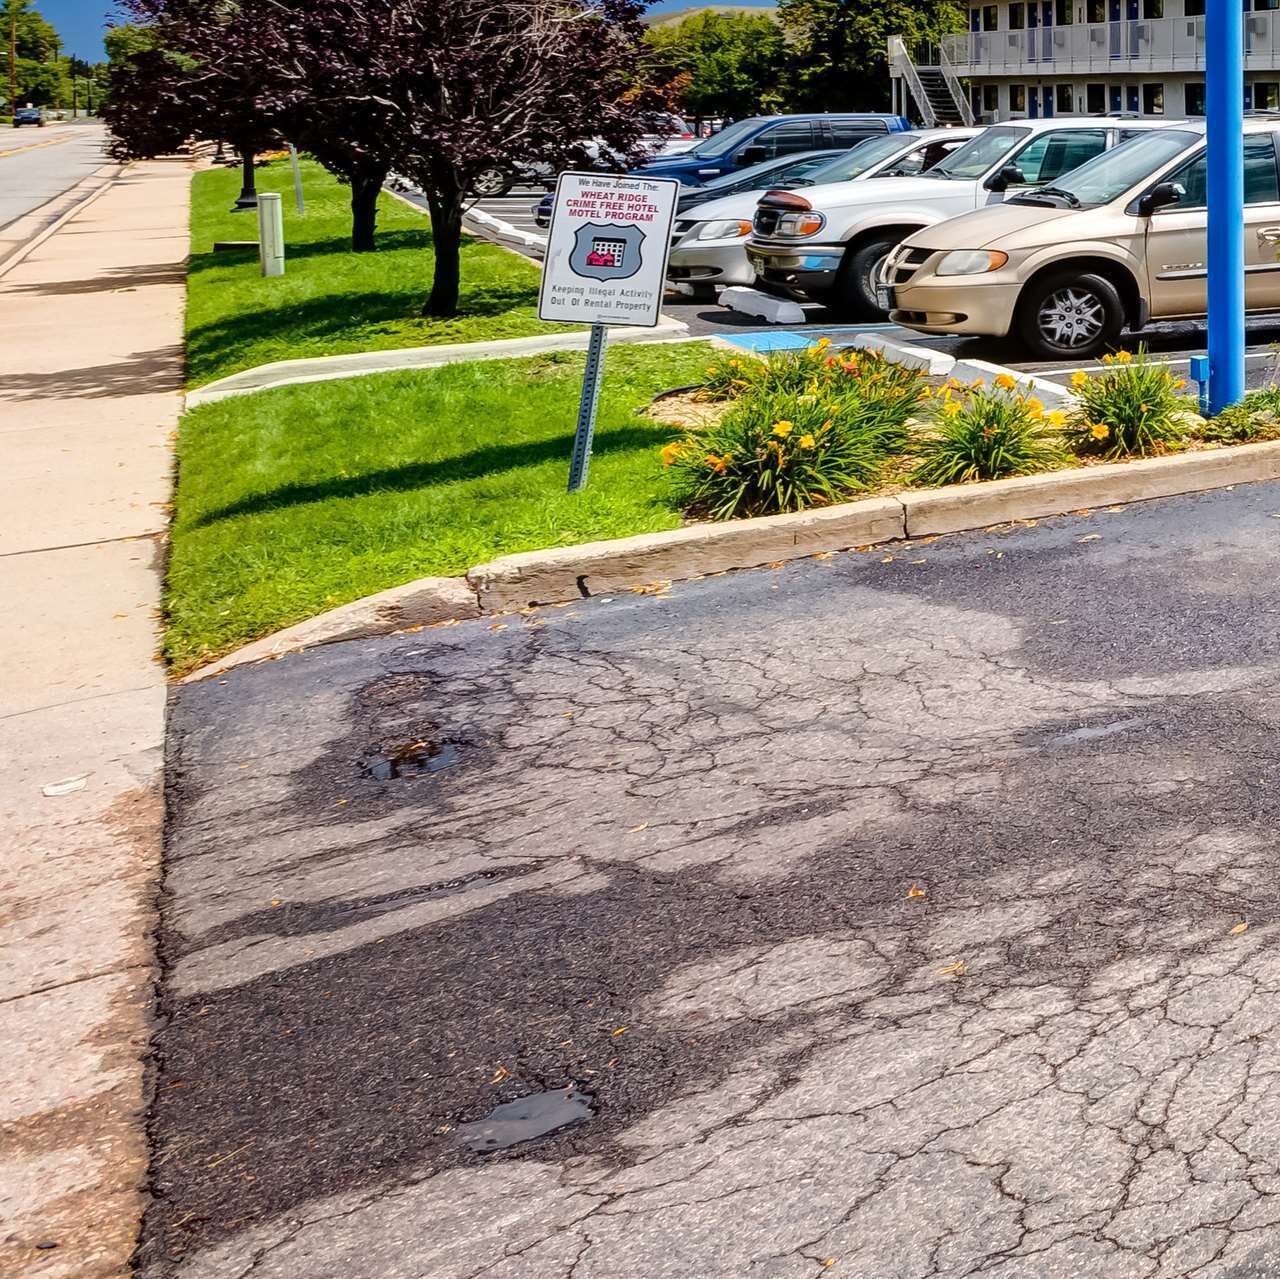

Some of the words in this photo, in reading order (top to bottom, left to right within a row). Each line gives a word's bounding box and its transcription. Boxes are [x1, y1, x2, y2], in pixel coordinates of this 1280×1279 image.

[578, 178, 590, 187] We
[592, 179, 611, 188] Have
[613, 180, 640, 190] Joined
[581, 191, 615, 200] WHEAT
[617, 193, 648, 203] RIDGE
[566, 199, 597, 209] CRIME
[599, 201, 625, 211] FREE
[627, 203, 659, 213] HOTEL
[569, 209, 601, 219] MOTEL
[605, 211, 654, 221] PROGRAM
[551, 285, 585, 296] Keeping
[589, 287, 616, 297] Illegal
[619, 289, 653, 300] Activity
[550, 297, 565, 306] Out
[571, 297, 580, 306] Of
[584, 299, 611, 308] Rental
[615, 301, 652, 312] Property
